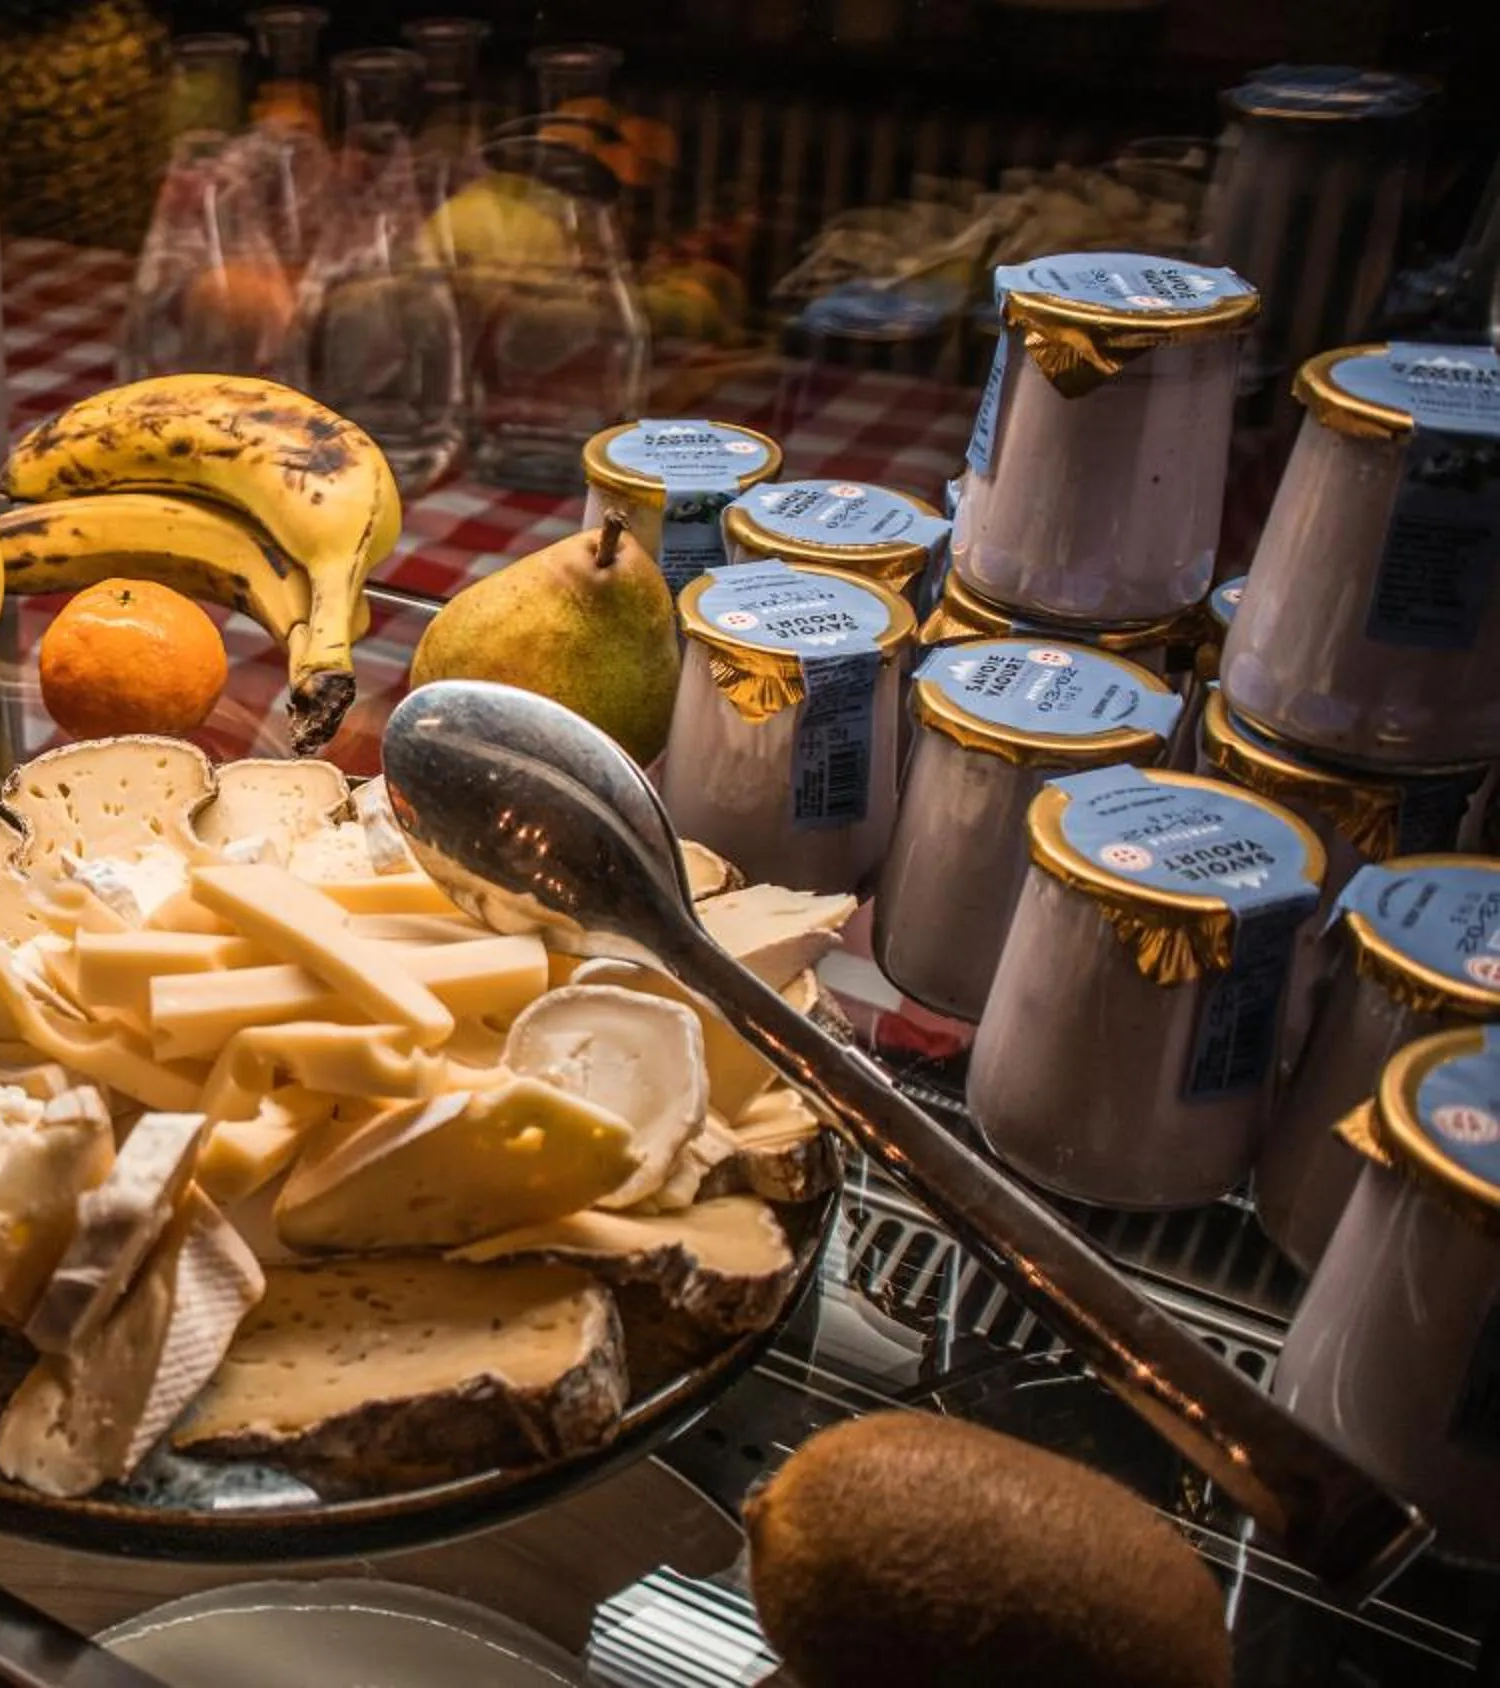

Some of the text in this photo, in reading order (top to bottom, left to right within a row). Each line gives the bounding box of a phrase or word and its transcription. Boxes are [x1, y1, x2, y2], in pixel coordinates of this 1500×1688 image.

[765, 612, 853, 631] YAOURT
[776, 621, 859, 639] SAVOIE
[965, 655, 1007, 692] SAVOIE
[984, 657, 1026, 697] YAOURT
[1163, 839, 1264, 871] YAOURT
[1179, 850, 1276, 882] SAVOIE
